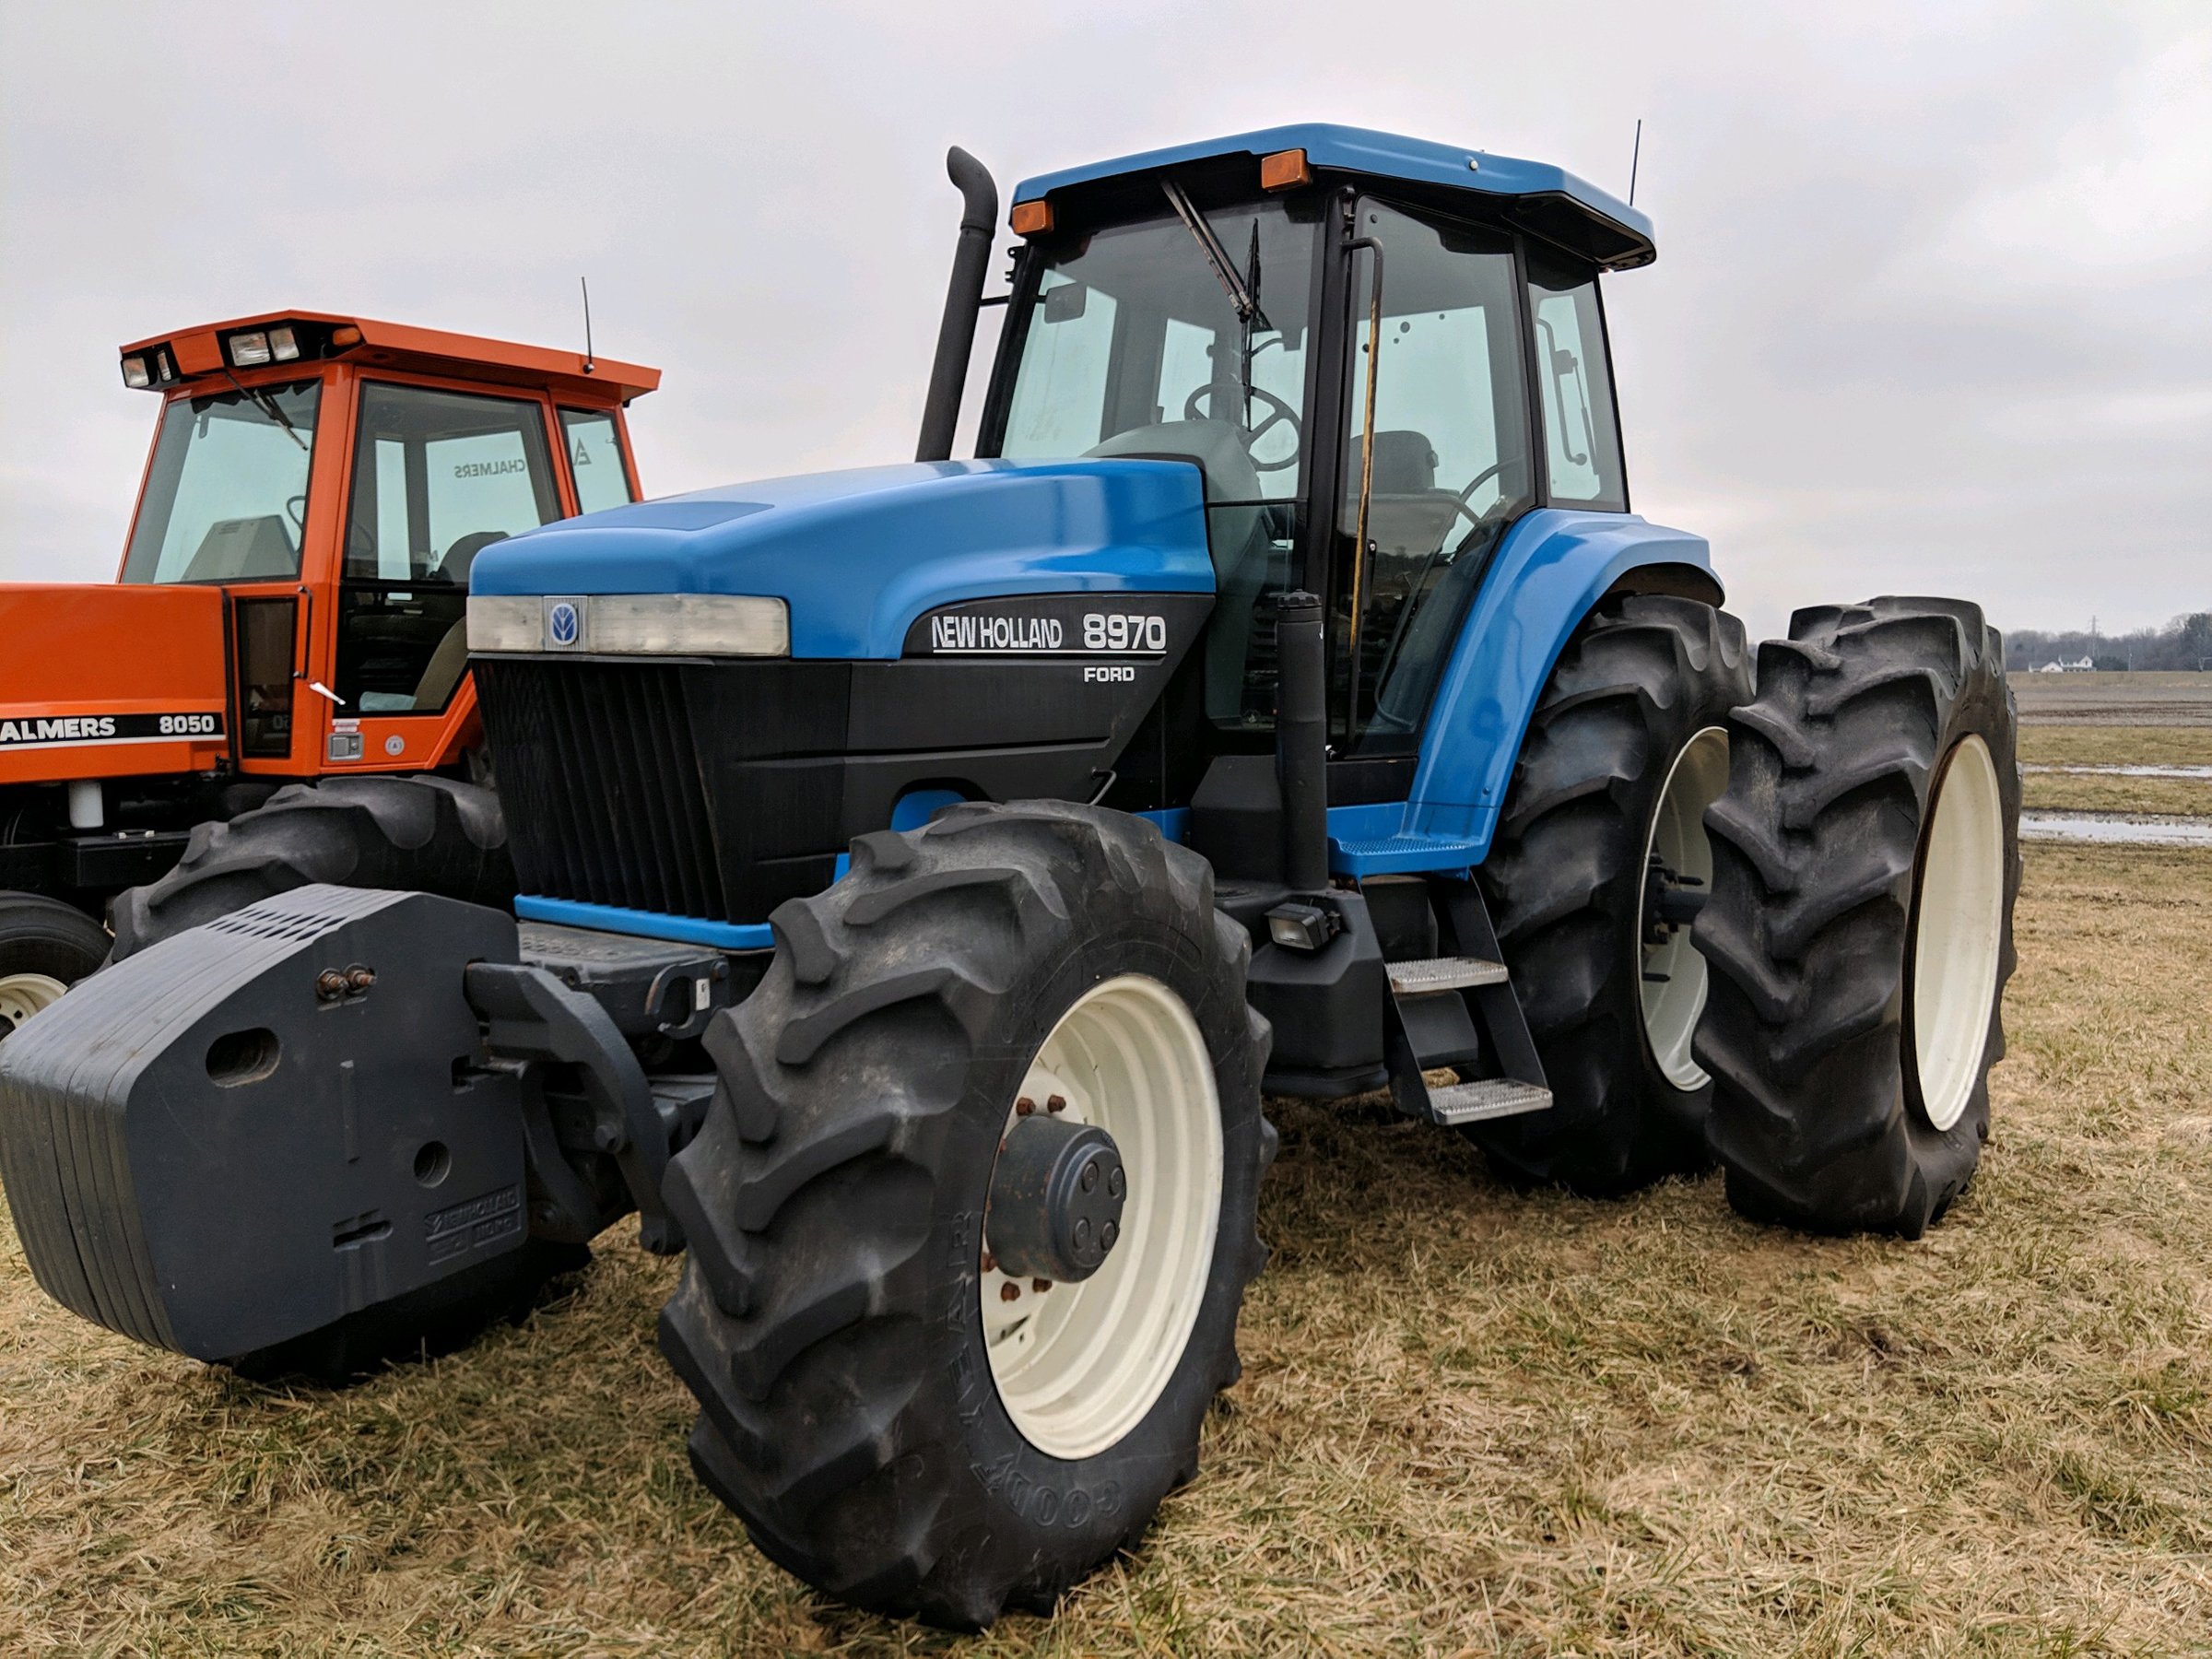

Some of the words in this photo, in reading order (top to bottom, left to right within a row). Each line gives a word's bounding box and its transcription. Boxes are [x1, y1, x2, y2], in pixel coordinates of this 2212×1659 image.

[980, 617, 1063, 649] HOLLAND
[1083, 613, 1167, 650] 8970
[1083, 667, 1135, 682] FORD
[159, 714, 215, 734] 8050
